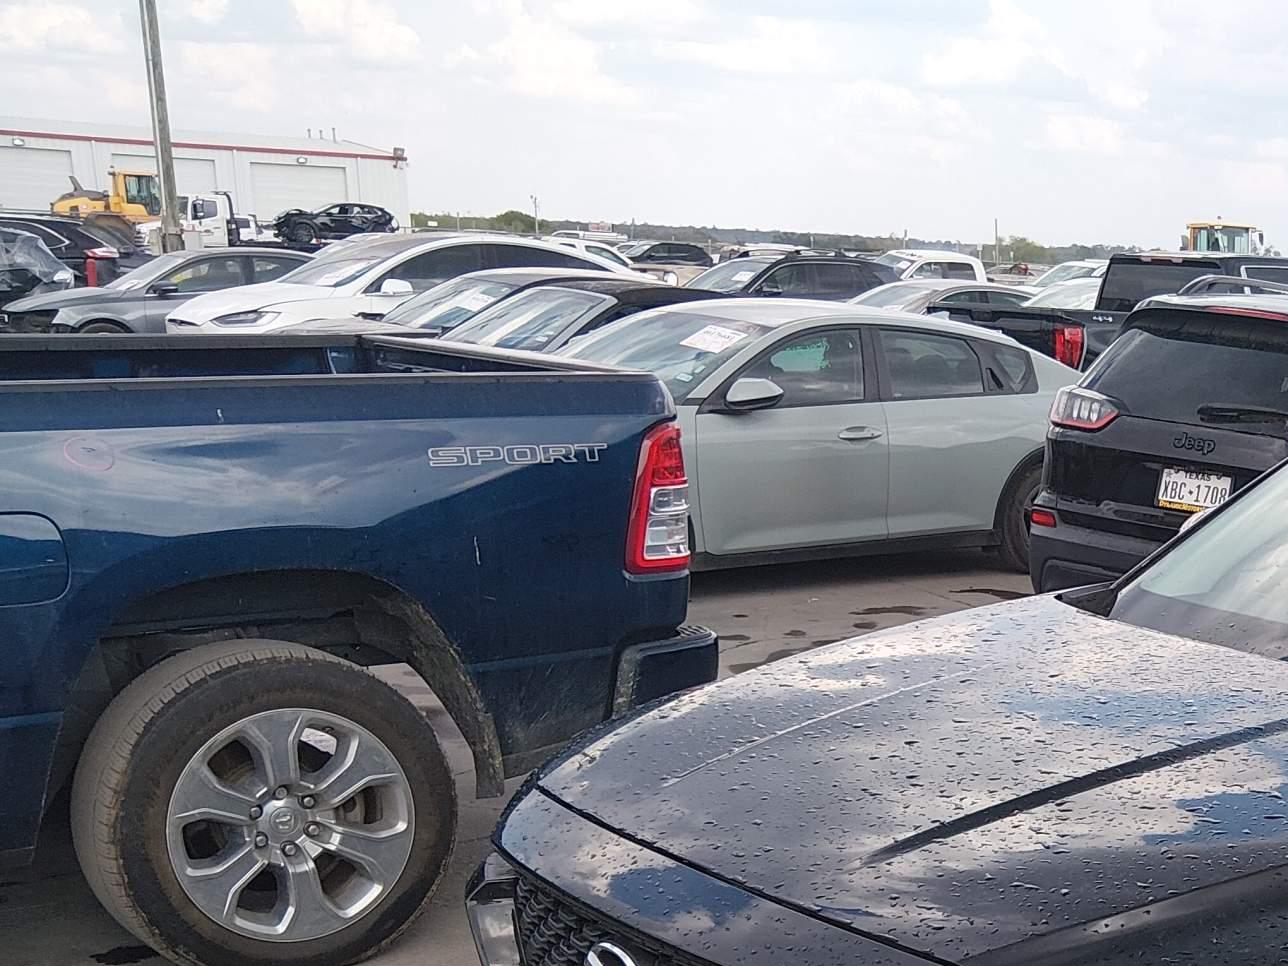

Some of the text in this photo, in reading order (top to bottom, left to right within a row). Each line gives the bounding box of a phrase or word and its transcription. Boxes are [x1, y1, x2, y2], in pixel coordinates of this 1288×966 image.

[427, 443, 608, 467] SPORT
[1173, 432, 1216, 456] Jeep
[1184, 471, 1211, 482] TEXAS
